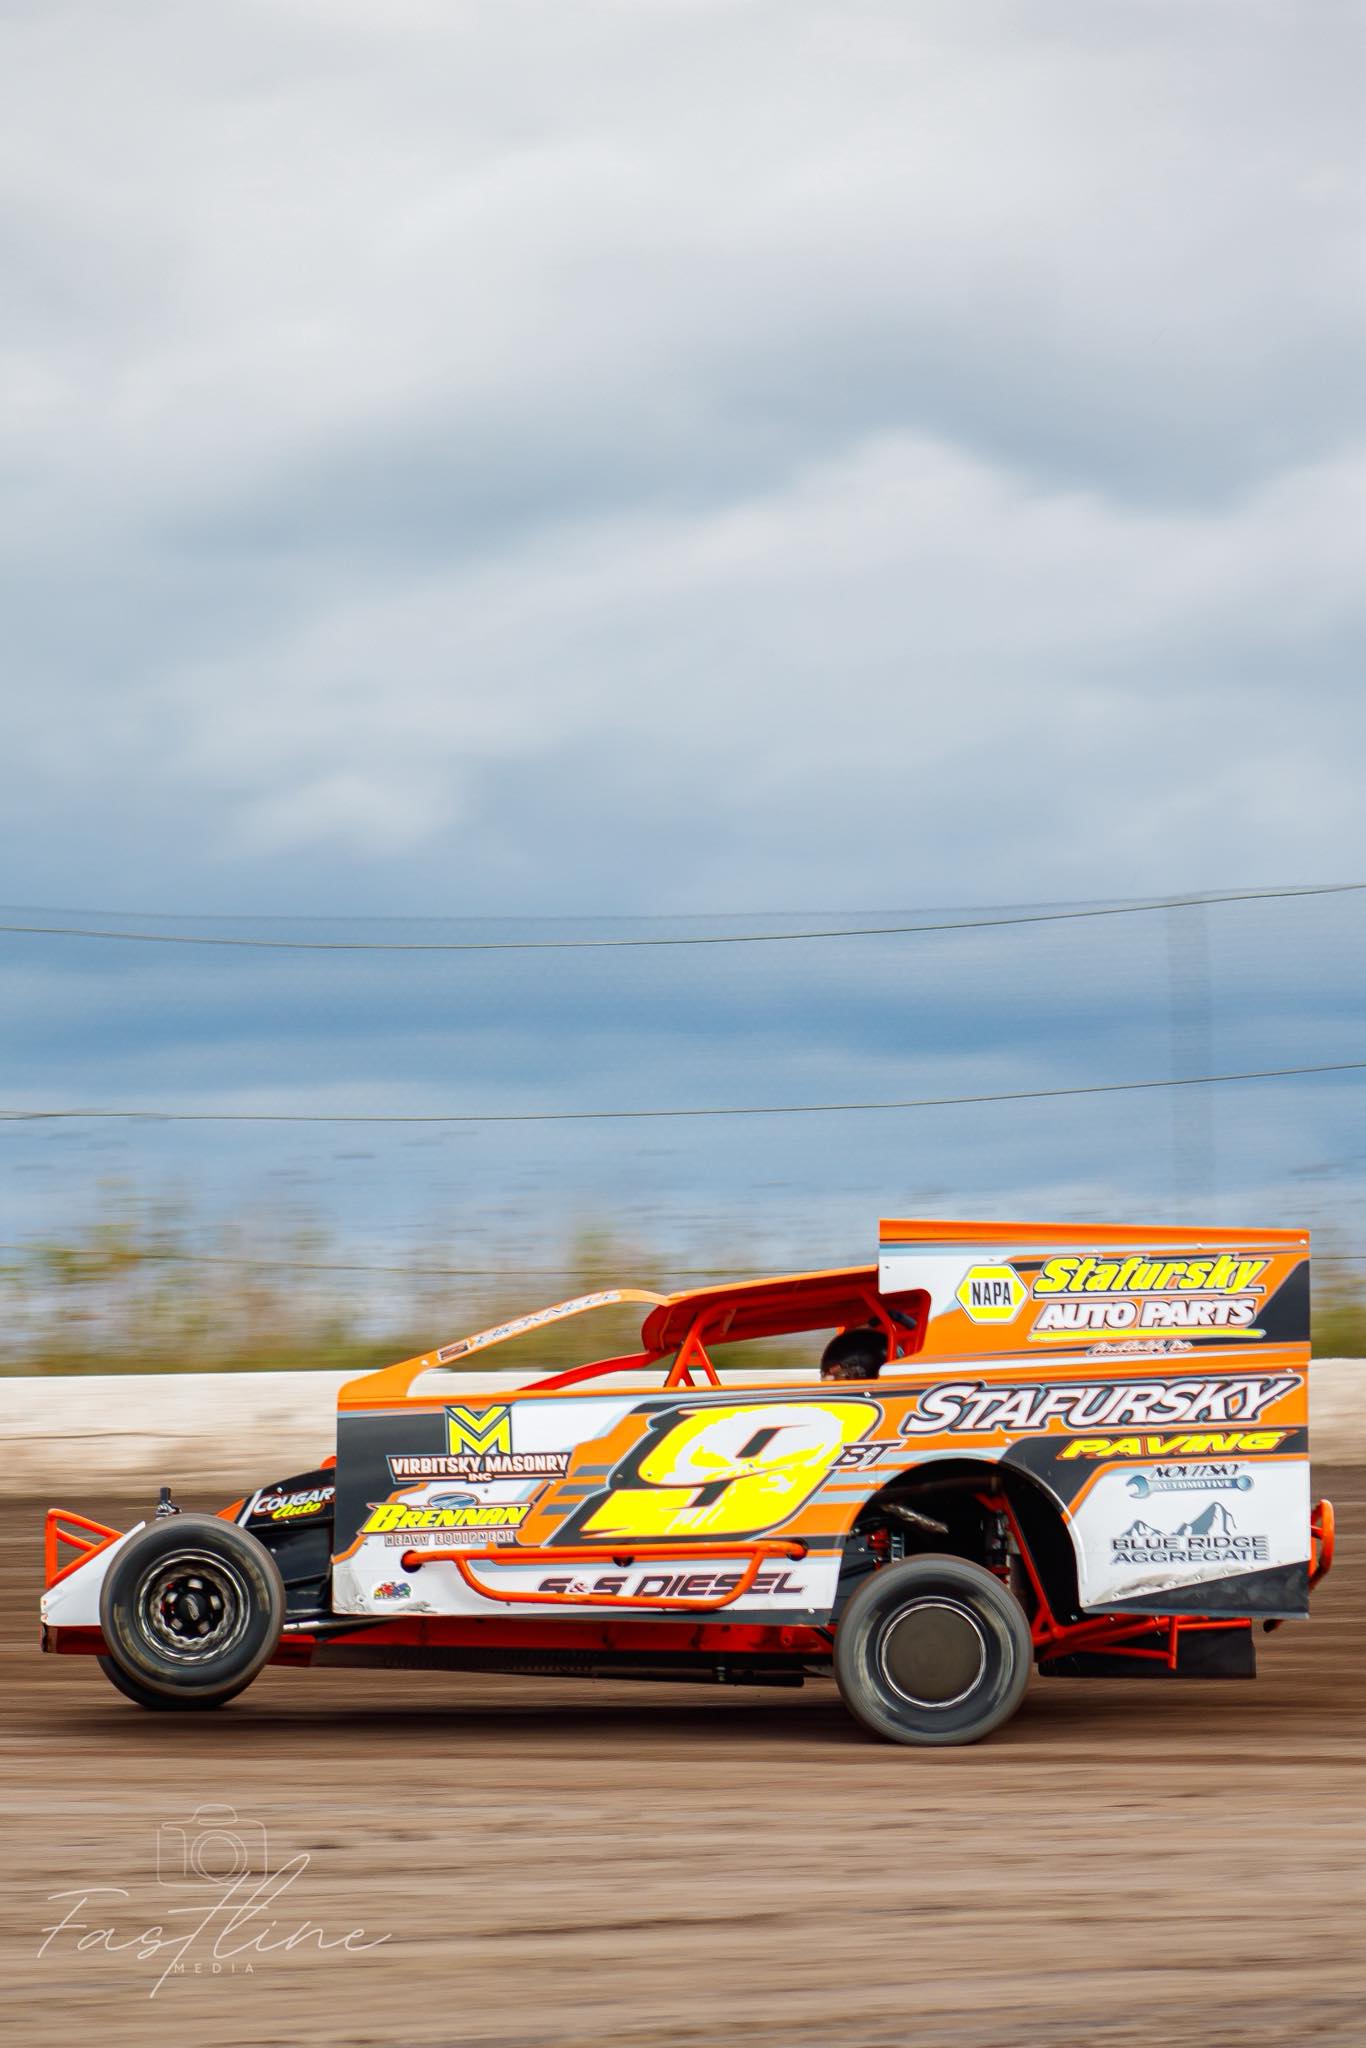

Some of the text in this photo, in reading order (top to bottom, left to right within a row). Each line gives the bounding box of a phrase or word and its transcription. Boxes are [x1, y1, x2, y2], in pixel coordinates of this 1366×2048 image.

[1033, 1256, 1267, 1294] Stafursky
[972, 1283, 1012, 1307] NAPA
[1034, 1299, 1256, 1330] AUTO PARTS
[902, 1377, 1301, 1436] STAFURSKY
[1058, 1432, 1287, 1459] PAVING
[391, 1455, 568, 1475] VIRBITSKY MASONRY
[468, 1473, 492, 1482] INC
[580, 1402, 880, 1538] 9
[254, 1487, 335, 1513] COUGAR
[361, 1503, 530, 1533] BRENNAN
[386, 1531, 513, 1546] HEAVY EQUIPMENT
[1113, 1535, 1268, 1550] BLUE RIDGE
[1113, 1550, 1268, 1563] AGGREGATE
[537, 1572, 805, 1597] S&S DIESEL
